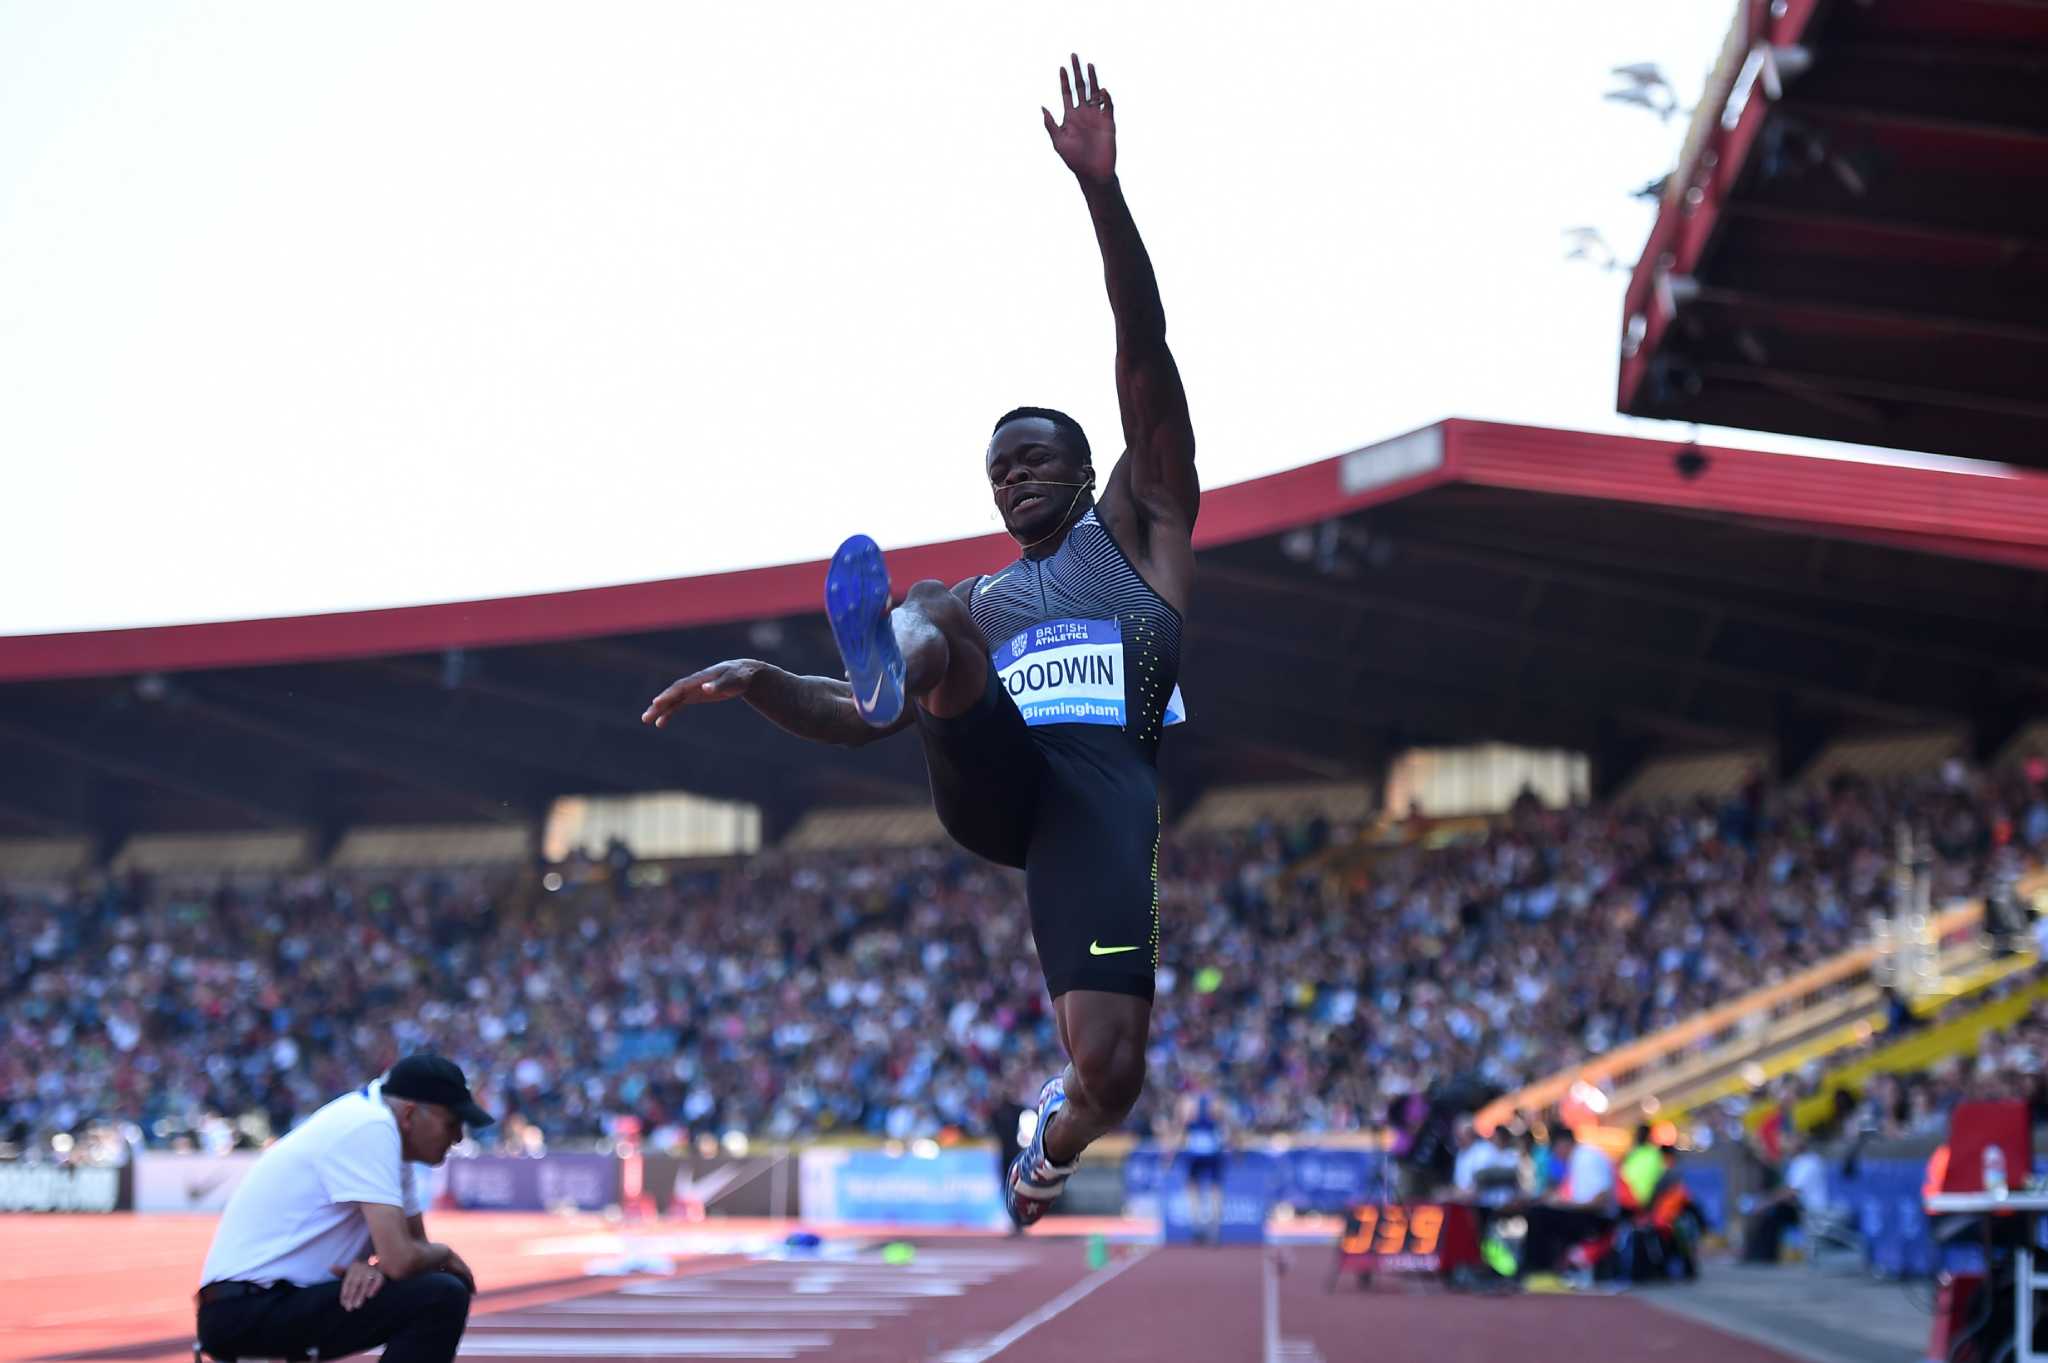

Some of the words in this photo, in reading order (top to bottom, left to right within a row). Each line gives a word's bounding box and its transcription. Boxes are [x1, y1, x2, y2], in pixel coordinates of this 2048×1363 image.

[1036, 623, 1087, 638] BRITISH
[1035, 632, 1089, 646] ATHLETICS
[1022, 702, 1119, 720] Birmingham
